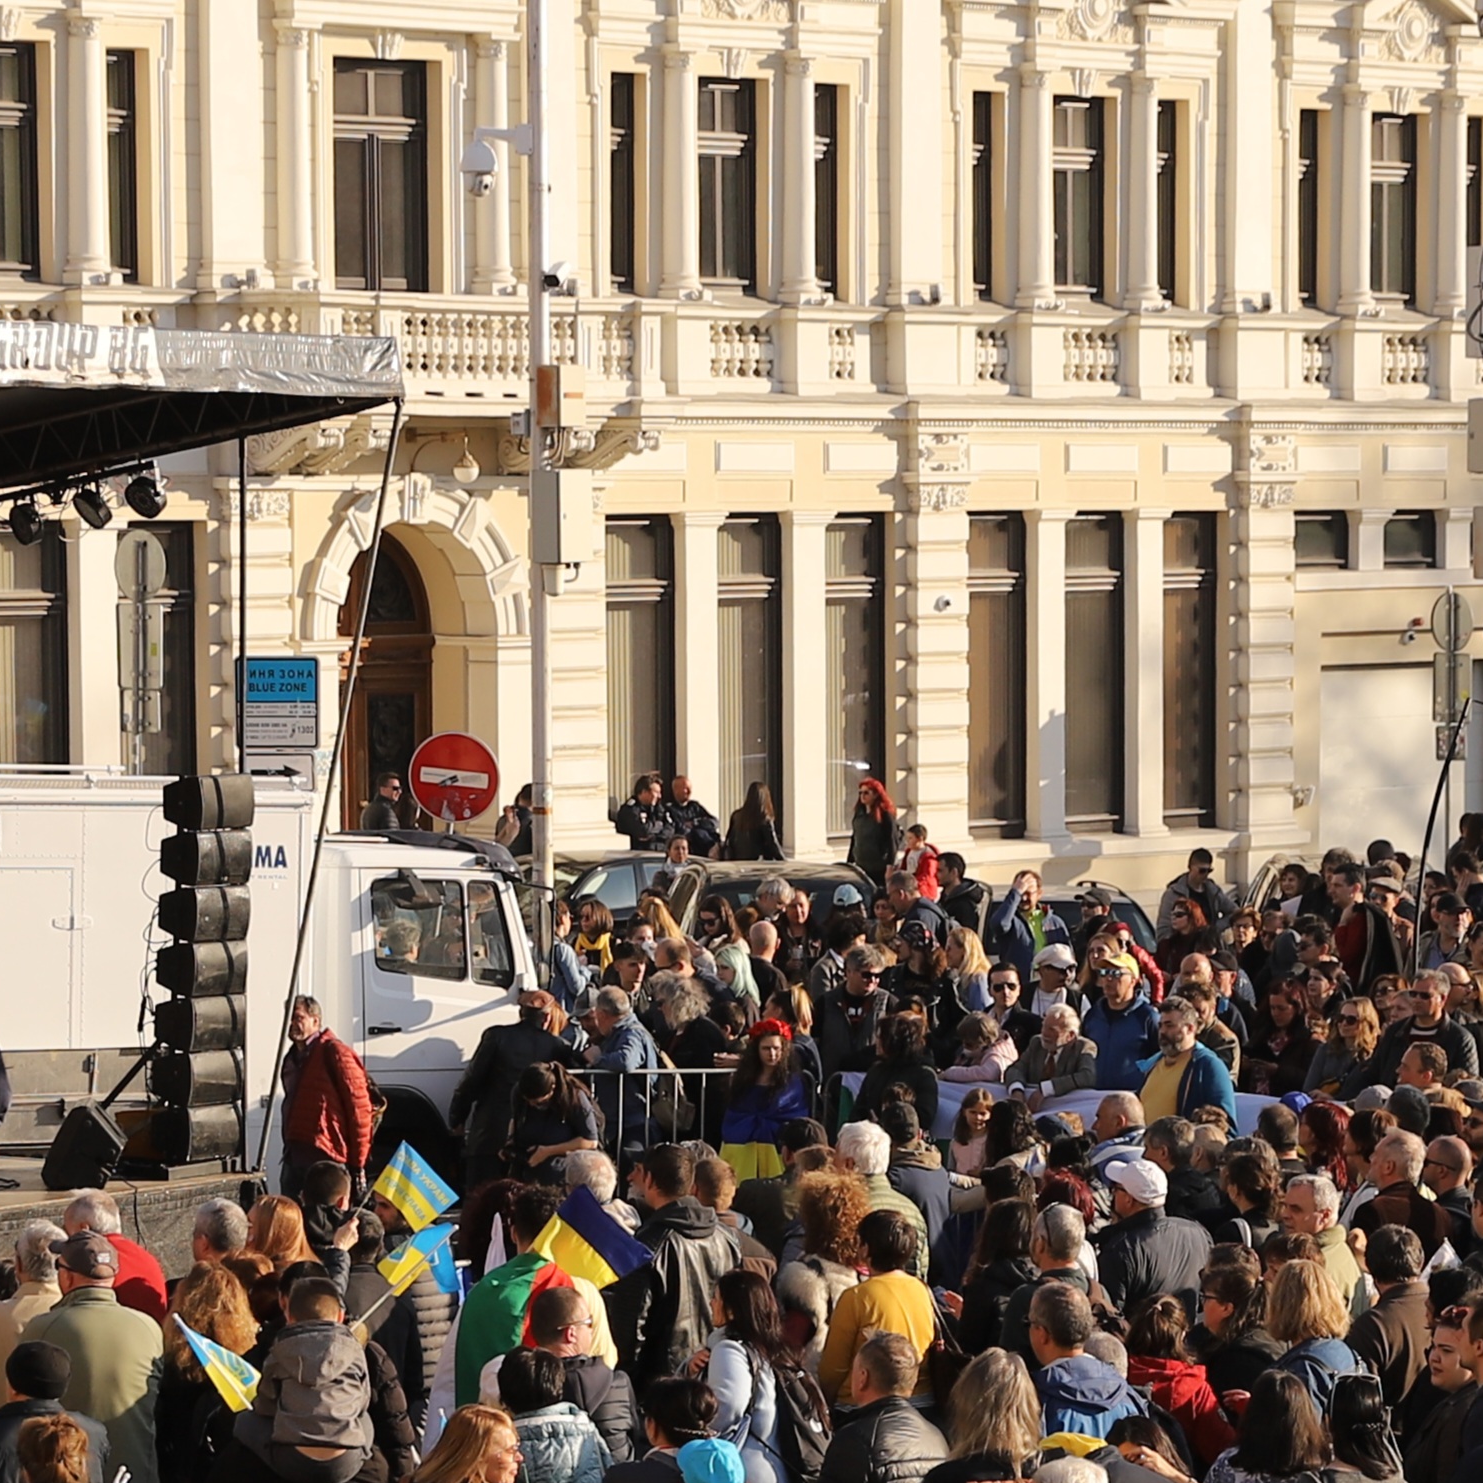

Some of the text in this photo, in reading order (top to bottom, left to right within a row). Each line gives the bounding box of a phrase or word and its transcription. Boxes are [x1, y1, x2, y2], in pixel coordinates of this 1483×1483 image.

[109, 325, 150, 378] BG
[249, 669, 314, 679] ИНЯ ЗОНА
[249, 682, 308, 693] BLUE ZONE
